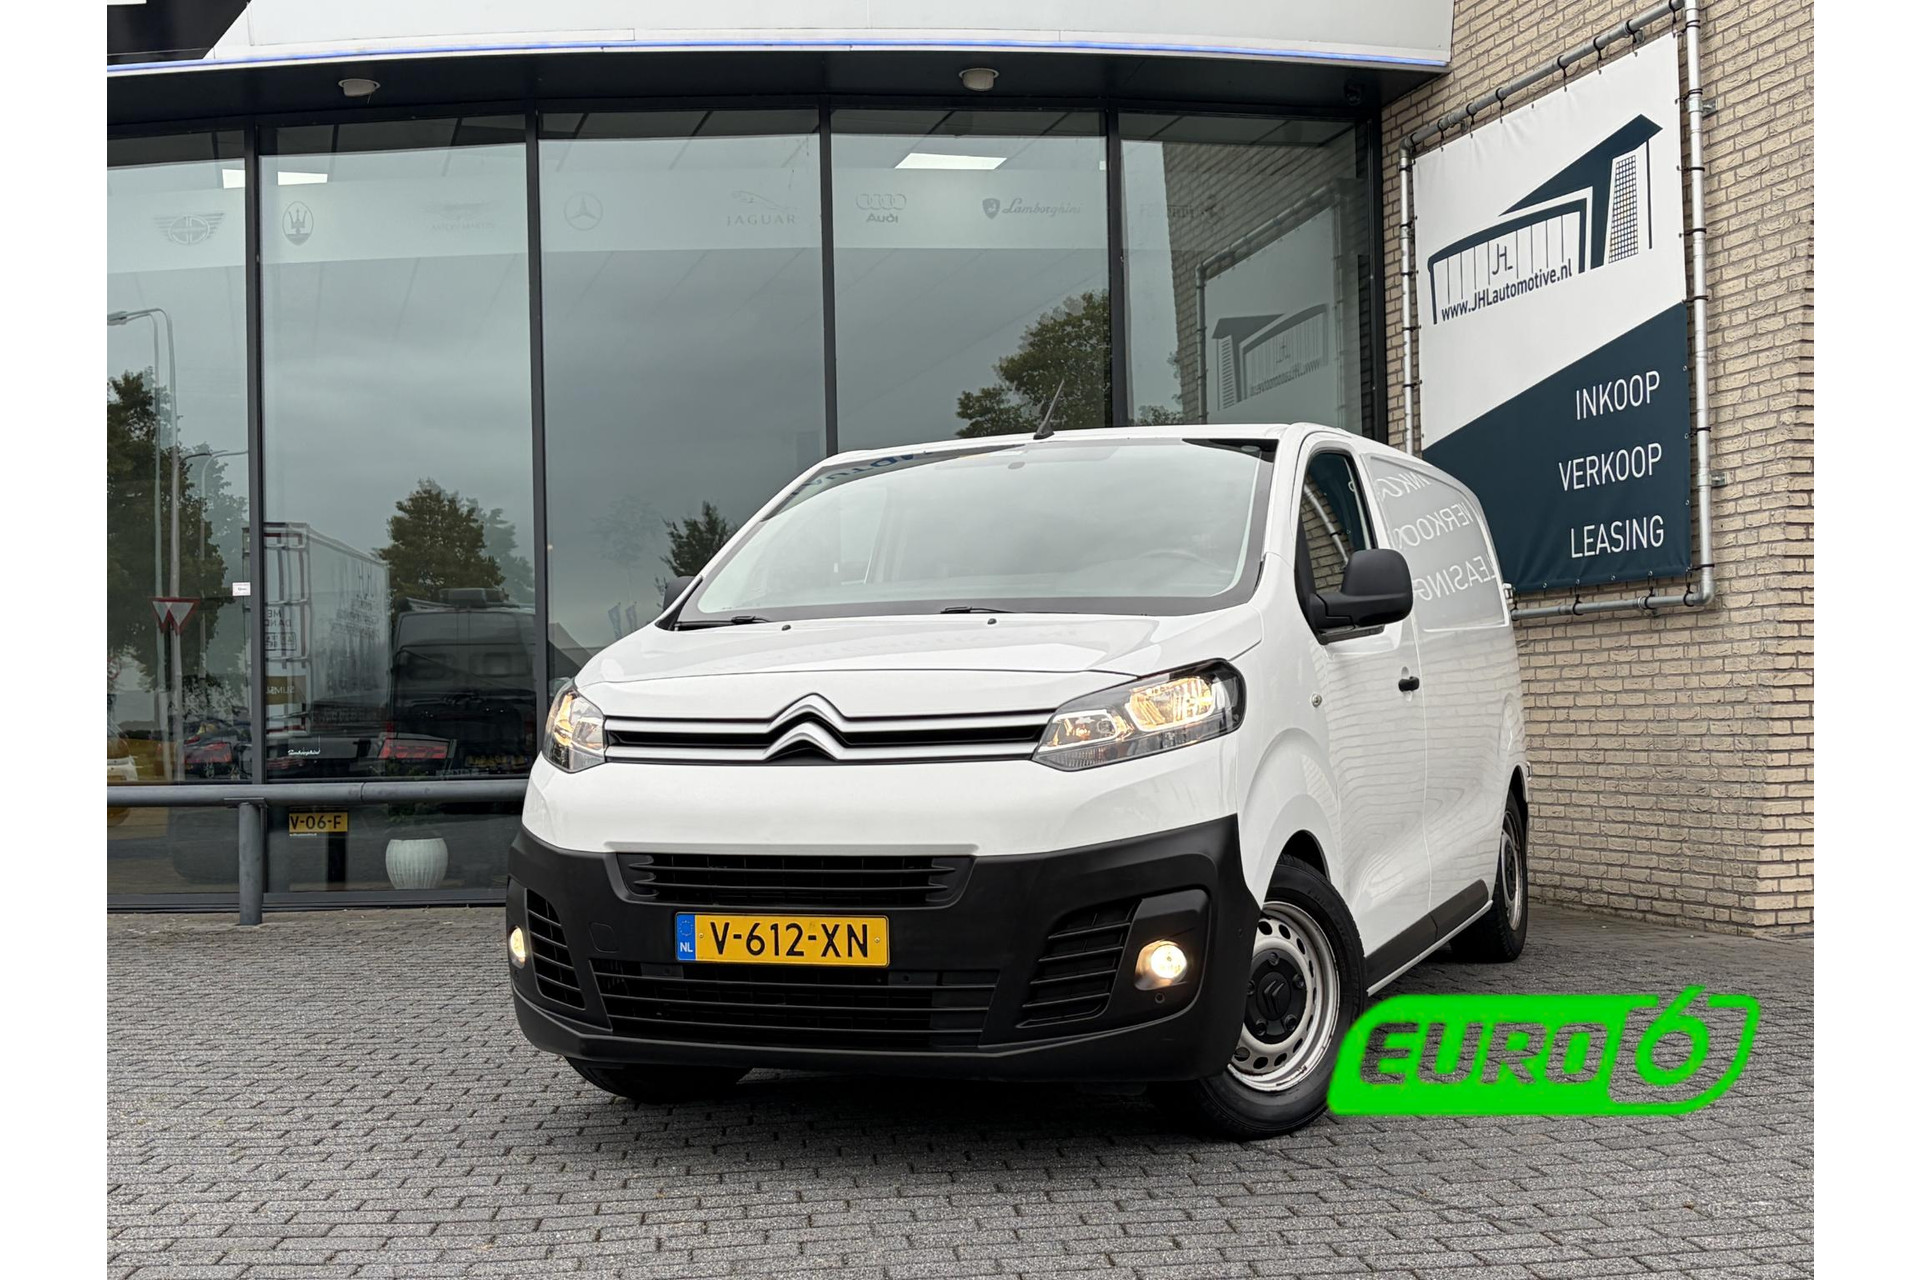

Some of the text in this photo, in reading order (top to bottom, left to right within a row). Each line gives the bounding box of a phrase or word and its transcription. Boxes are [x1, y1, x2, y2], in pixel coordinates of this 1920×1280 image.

[726, 213, 797, 226] JAGUAR
[866, 212, 899, 224] Audi
[1001, 197, 1084, 218] Lamborghini
[1441, 258, 1572, 322] www.JHLautomotive.nl
[1576, 370, 1660, 421] INKOOP
[1558, 442, 1663, 492] VERKOOP
[1570, 514, 1664, 559] LEASING
[290, 815, 342, 830] V-06-F
[679, 921, 868, 958] NL V-612-XN
